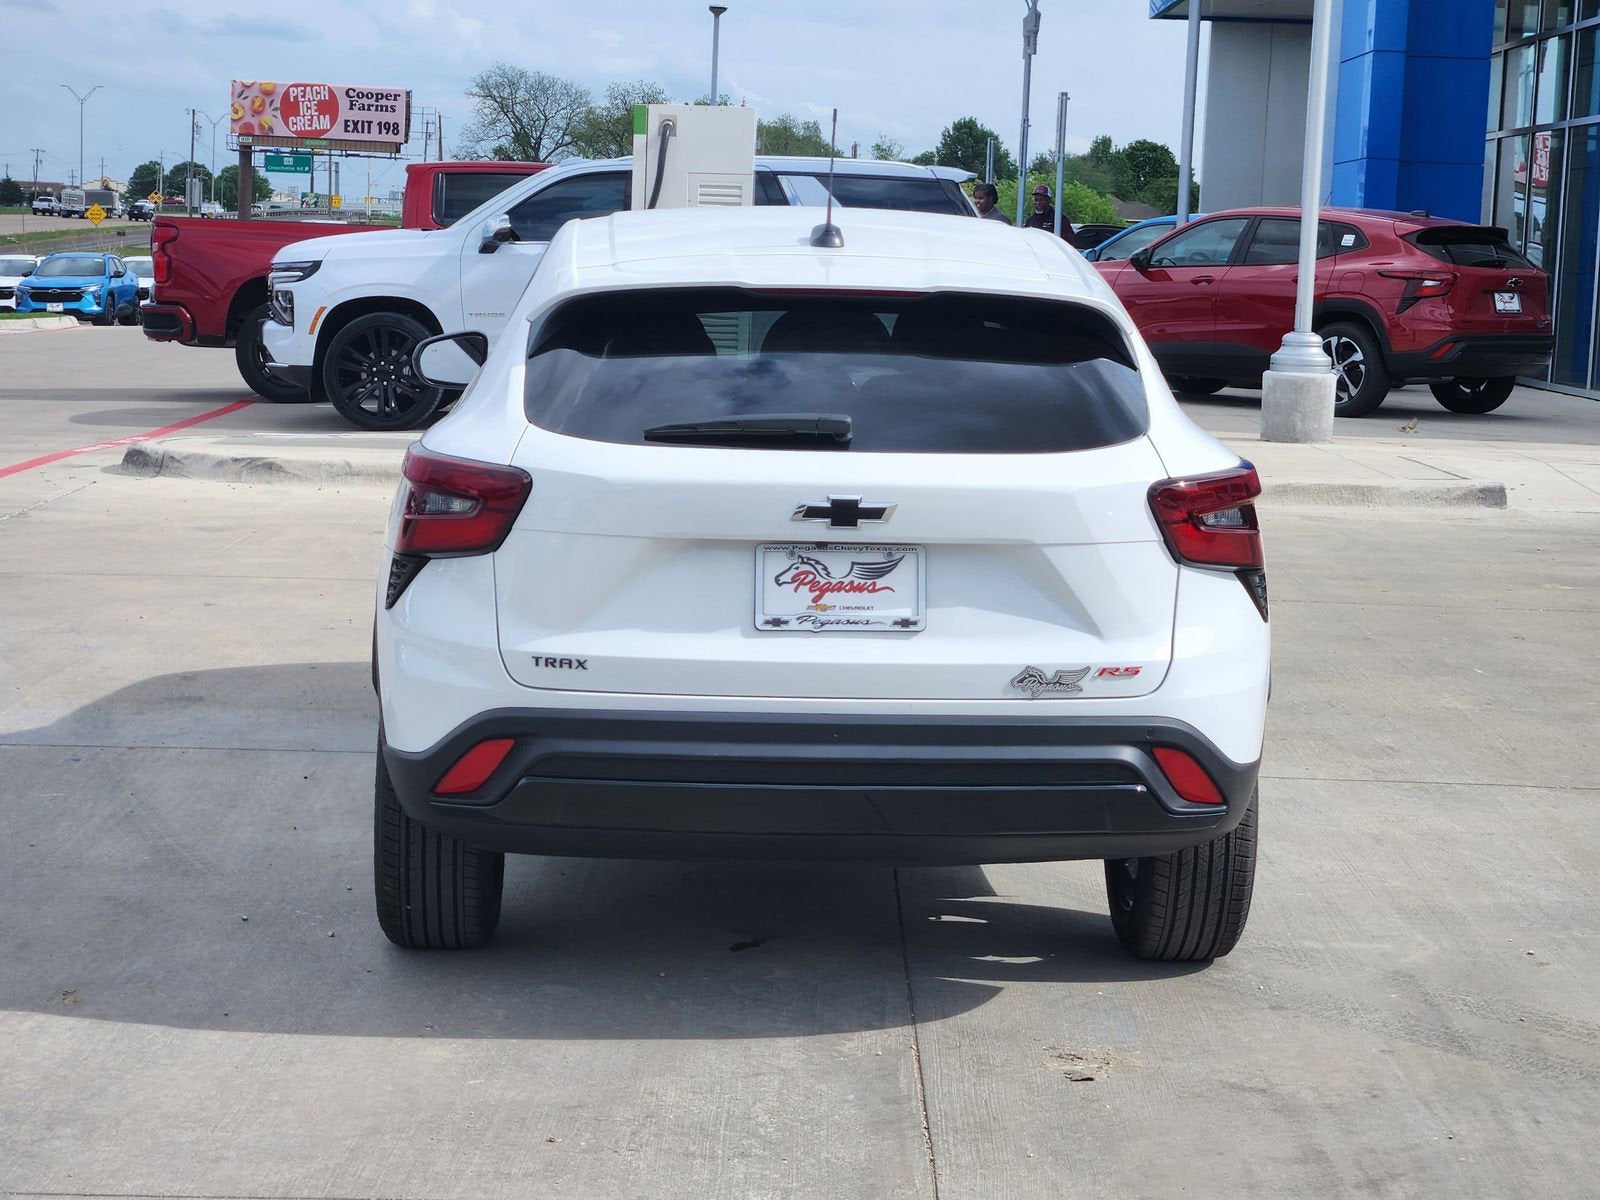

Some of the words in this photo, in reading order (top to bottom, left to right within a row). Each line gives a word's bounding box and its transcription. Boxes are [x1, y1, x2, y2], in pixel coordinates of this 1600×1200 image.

[289, 85, 329, 101] PEACH
[345, 88, 401, 102] Cooper
[299, 102, 319, 116] ICE
[349, 100, 396, 113] Farms
[288, 115, 330, 131] CREAM
[343, 119, 373, 134] EXIT
[377, 121, 400, 136] 198
[791, 570, 896, 604] Pegasus
[796, 615, 887, 629] Pegasus
[531, 656, 588, 670] TRAX
[1092, 665, 1143, 678] RS
[1022, 677, 1083, 697] Pegasus
